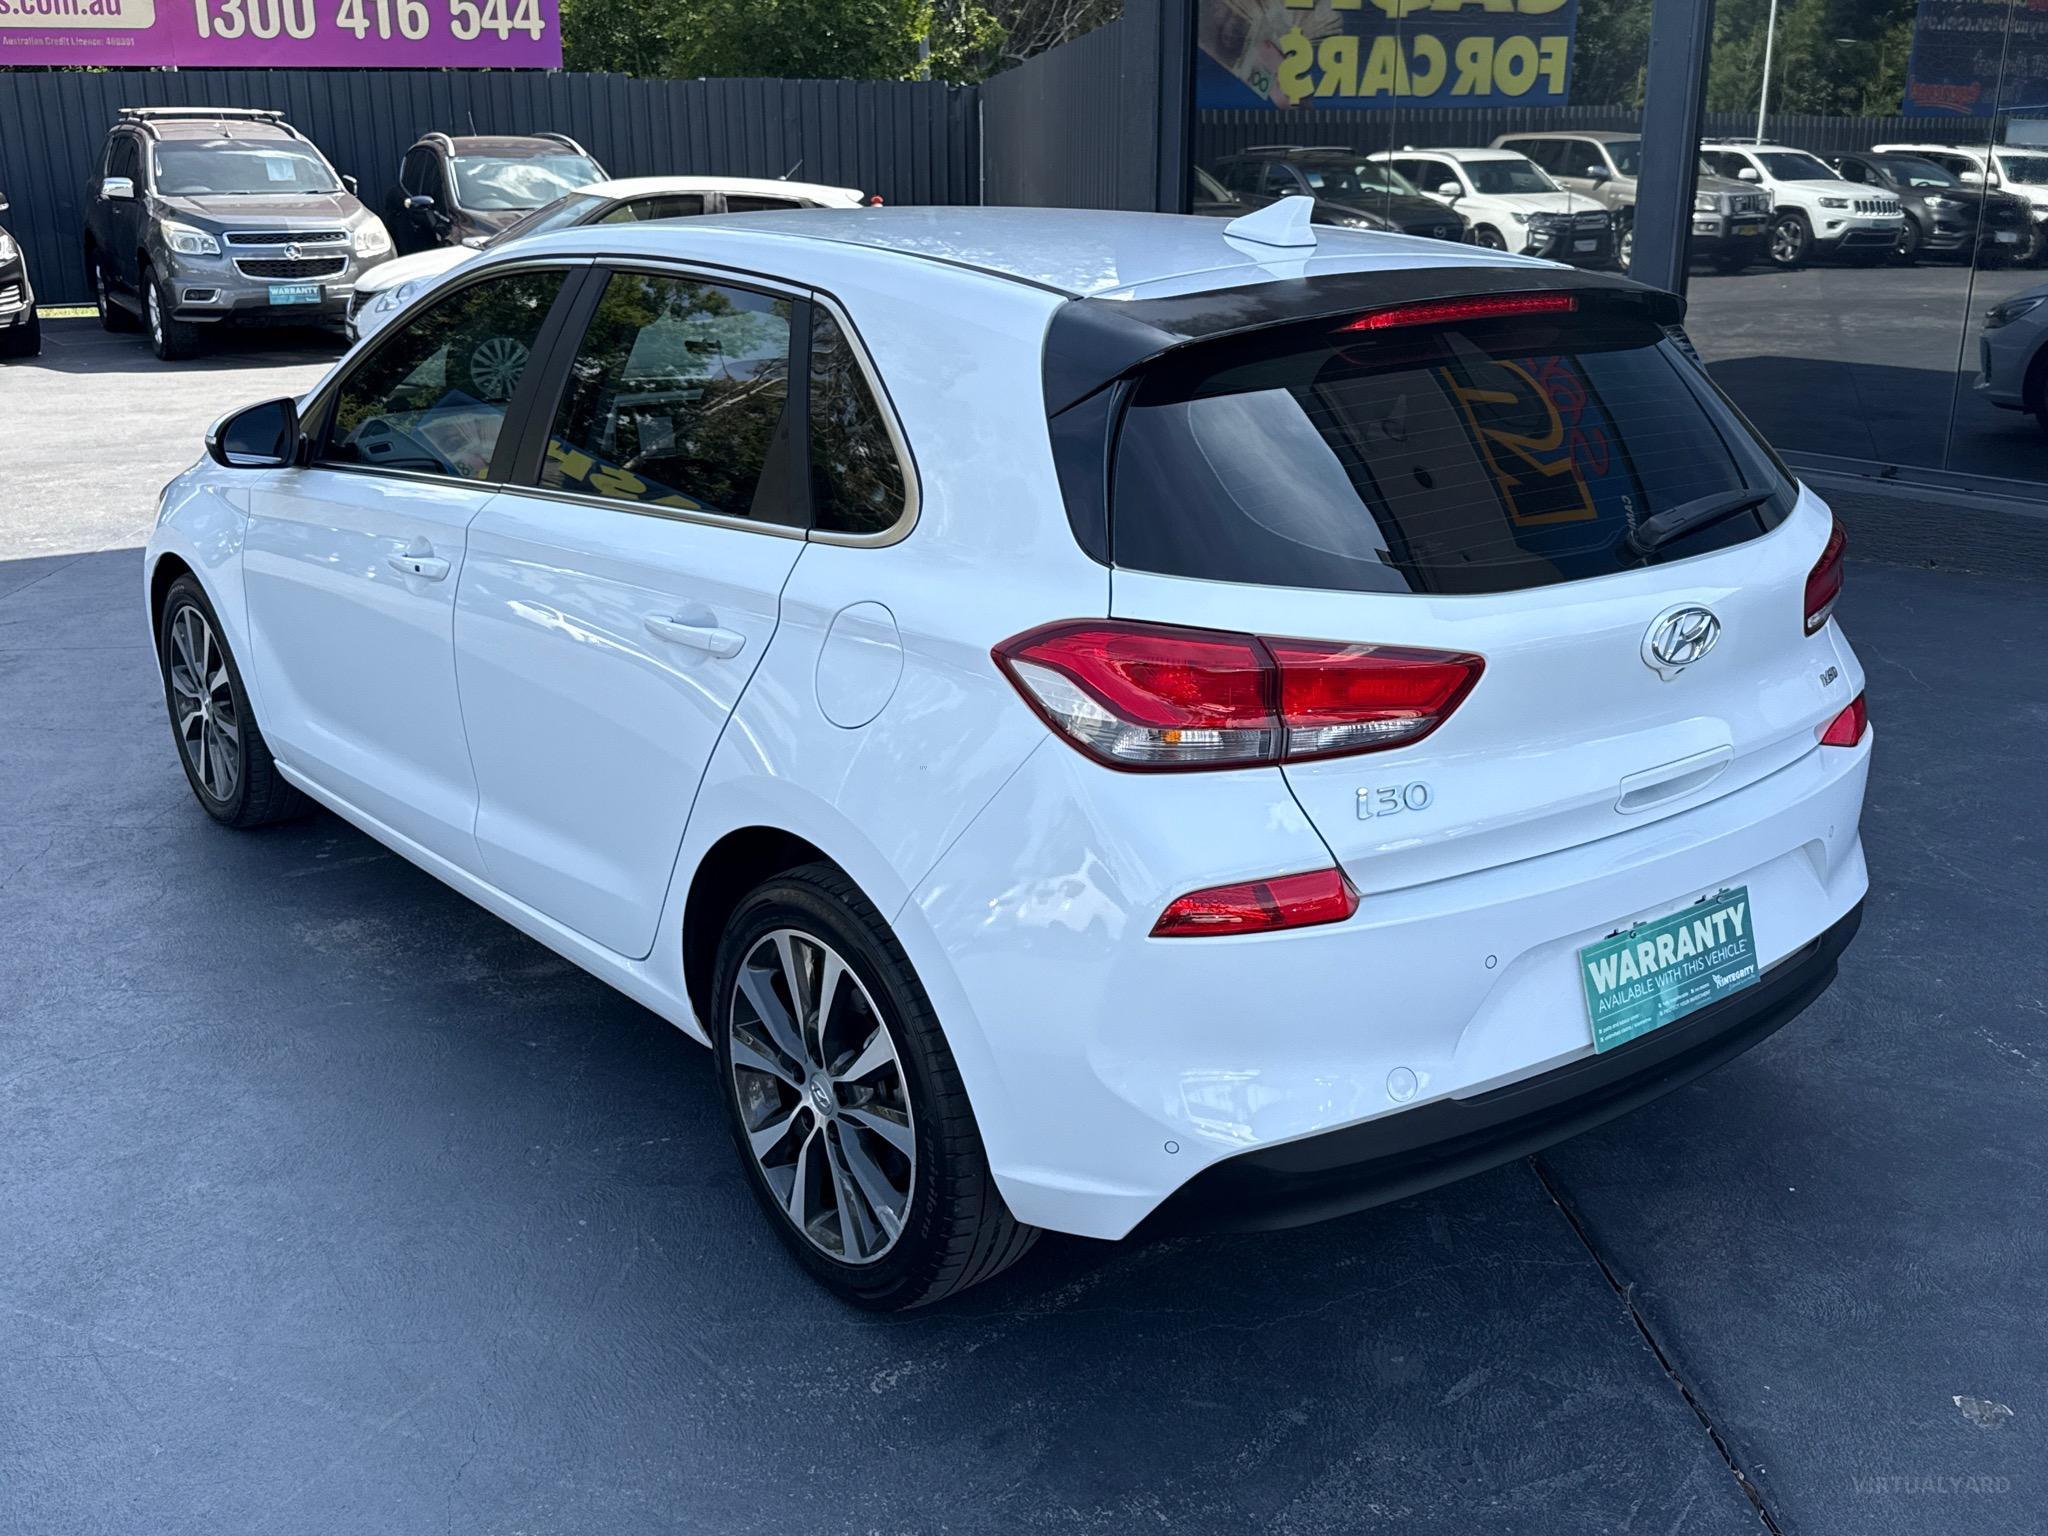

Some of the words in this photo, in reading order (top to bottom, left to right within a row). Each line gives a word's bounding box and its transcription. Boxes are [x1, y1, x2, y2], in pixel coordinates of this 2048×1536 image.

[195, 0, 316, 39] 1300
[336, 0, 430, 40] 416
[450, 0, 546, 40] 544
[3, 36, 44, 46] Australian
[45, 36, 69, 46] Credit
[269, 287, 318, 295] WARRANTY
[1356, 781, 1433, 820] i30
[1588, 902, 1745, 994] WARRANTY
[1599, 980, 1654, 1014] AVAILABLE
[1655, 970, 1681, 988] WITH
[1683, 960, 1703, 977] THIS
[1705, 939, 1747, 967] VEHICLE
[1721, 965, 1754, 986] INTEGRITY
